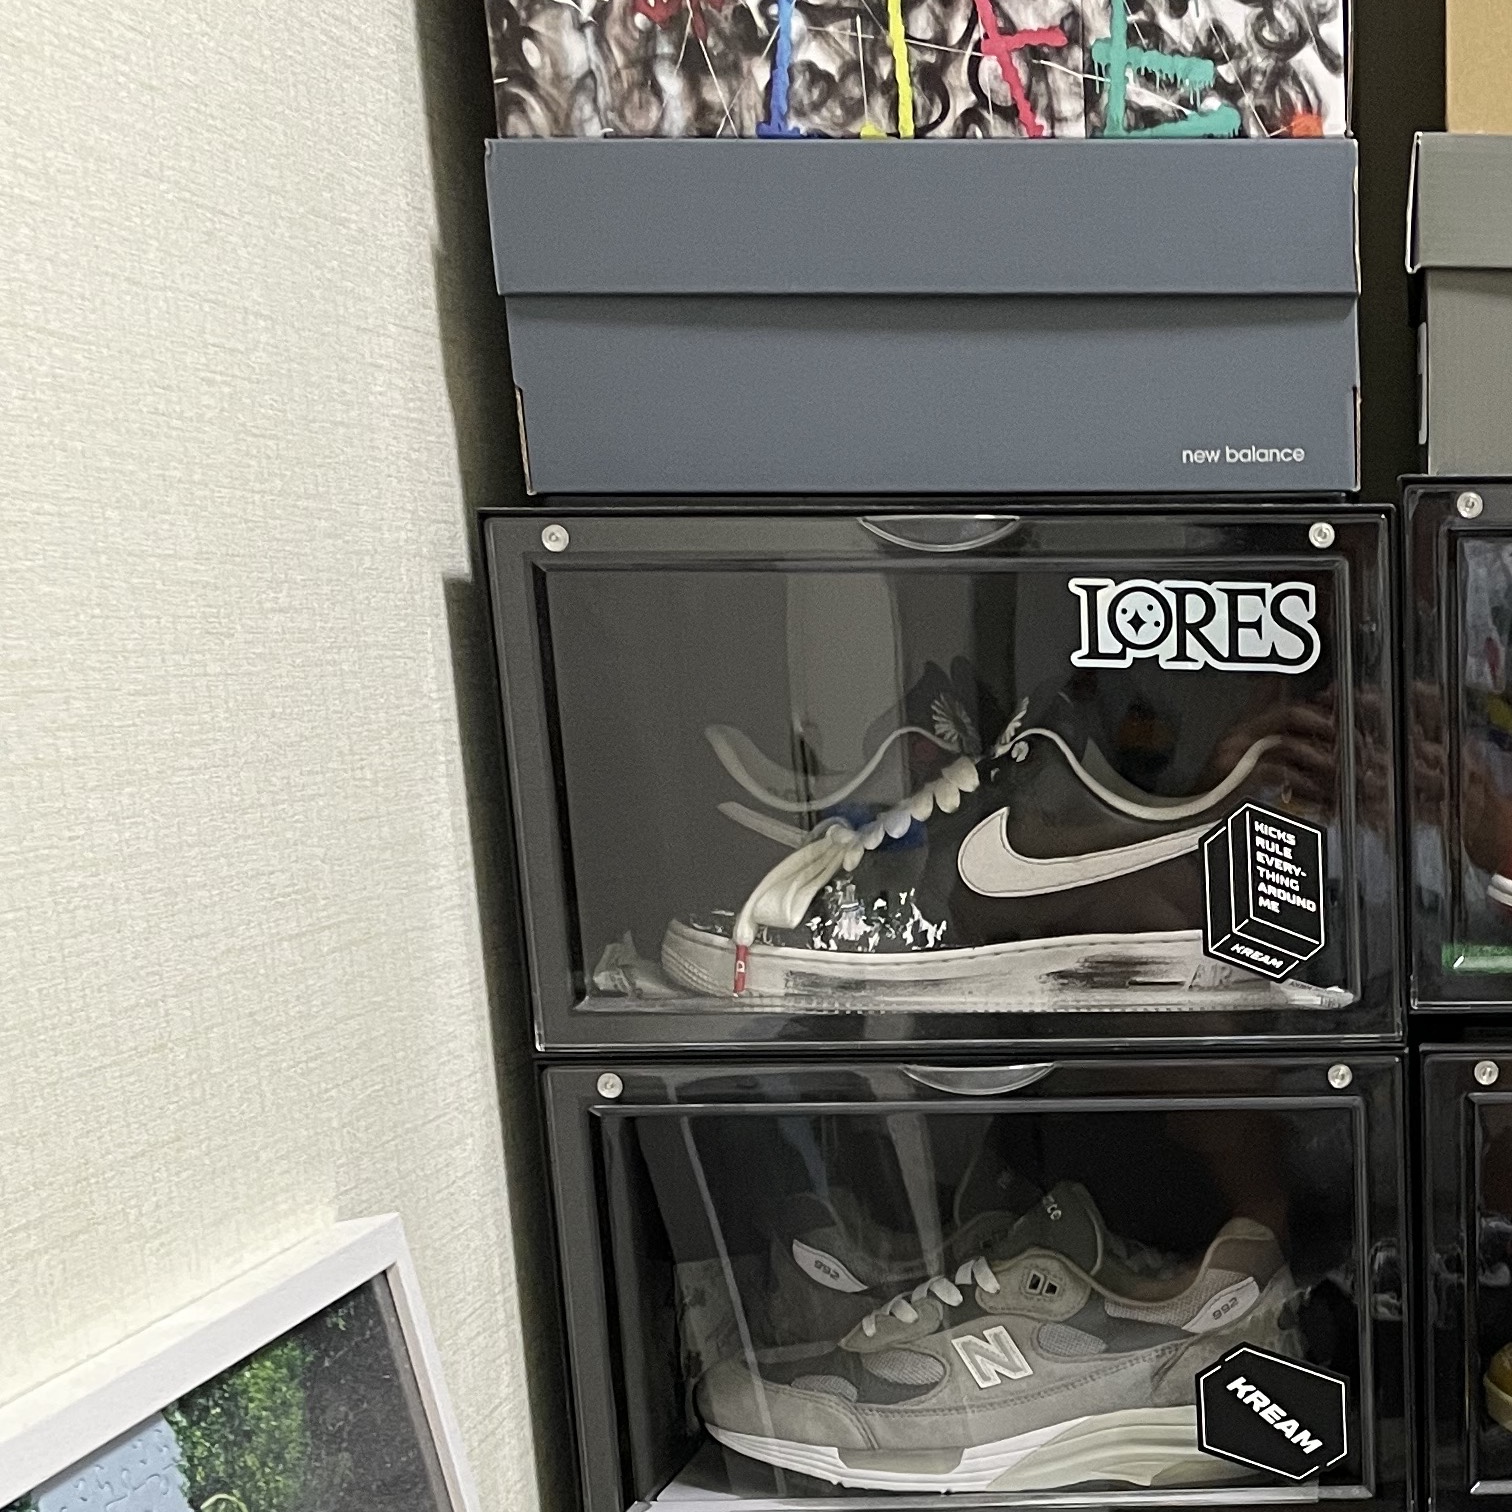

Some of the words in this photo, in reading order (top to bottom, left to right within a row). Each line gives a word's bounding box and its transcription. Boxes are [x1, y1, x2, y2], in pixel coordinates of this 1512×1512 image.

[1182, 447, 1220, 464] new
[1226, 445, 1305, 463] balance
[1070, 580, 1319, 671] LORES
[1254, 820, 1296, 846] KICKS
[1255, 836, 1292, 859] RULE
[1256, 851, 1307, 877] EVERY-
[1257, 866, 1299, 892] THING
[1258, 881, 1317, 912] AROUND
[1258, 896, 1280, 914] ME
[1231, 943, 1284, 969] KREAM
[1212, 1297, 1238, 1320] 992
[951, 1325, 1034, 1389] N
[1226, 1376, 1323, 1455] KREAM
